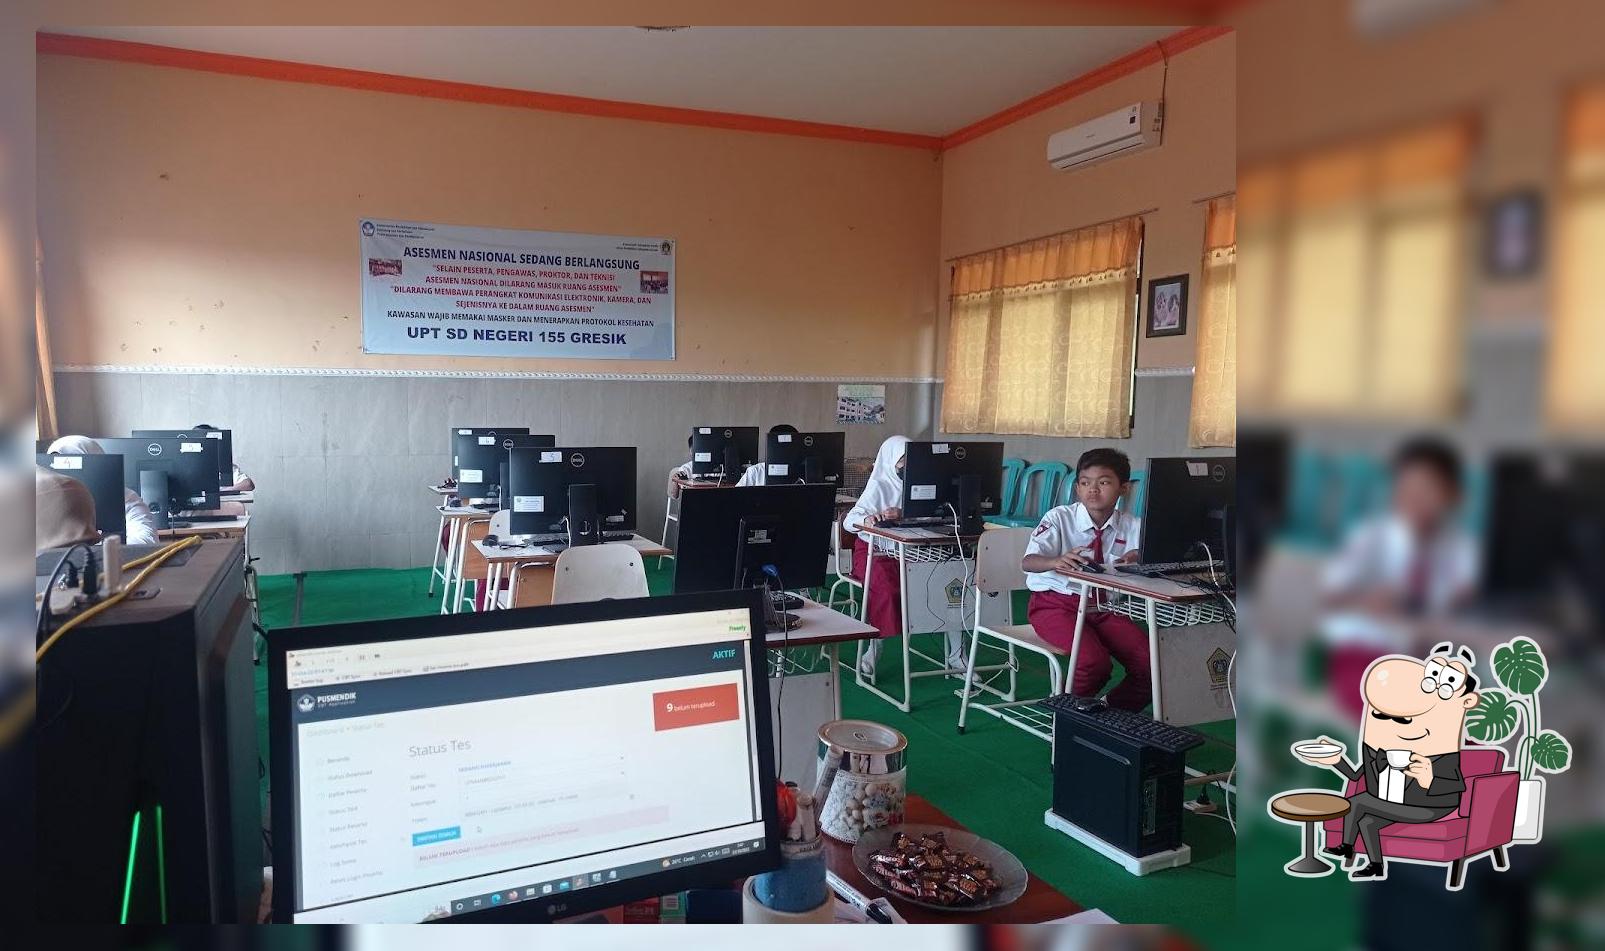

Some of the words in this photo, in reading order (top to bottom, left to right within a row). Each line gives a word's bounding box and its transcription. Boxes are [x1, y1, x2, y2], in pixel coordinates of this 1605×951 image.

[404, 247, 456, 259] ASESMEN
[460, 250, 516, 263] NASIONAL
[520, 254, 562, 266] SEDANG
[565, 257, 640, 270] BERLANGSUNG
[464, 266, 493, 276] PESERTA,
[496, 268, 538, 279] PENGAWAS,
[539, 271, 570, 280] PROKTOR,
[426, 276, 459, 284] ASESMEN
[461, 278, 497, 286] NASIONAL
[500, 280, 536, 289] DILARANG
[434, 288, 473, 296] MEMBAWA
[476, 290, 516, 298] PERANGKAT
[519, 292, 564, 300] KOMUNIKASI
[456, 300, 497, 309] SEJENISNYA
[509, 302, 534, 311] DALAM
[388, 310, 425, 319] KAWASAN
[428, 312, 449, 321] WAJIB
[451, 313, 485, 321] MEMAKAI
[534, 317, 580, 325] MENERAPKAN
[408, 327, 440, 339] UPT
[446, 328, 467, 339] SD
[474, 329, 532, 342] NEGERI
[539, 332, 565, 342] 155
[571, 332, 626, 344] GRESIK
[712, 650, 736, 660] AKTIF
[317, 692, 356, 704] PUSMENDIK
[666, 702, 674, 712] 9
[409, 742, 448, 758] Status
[450, 740, 472, 750] Tes
